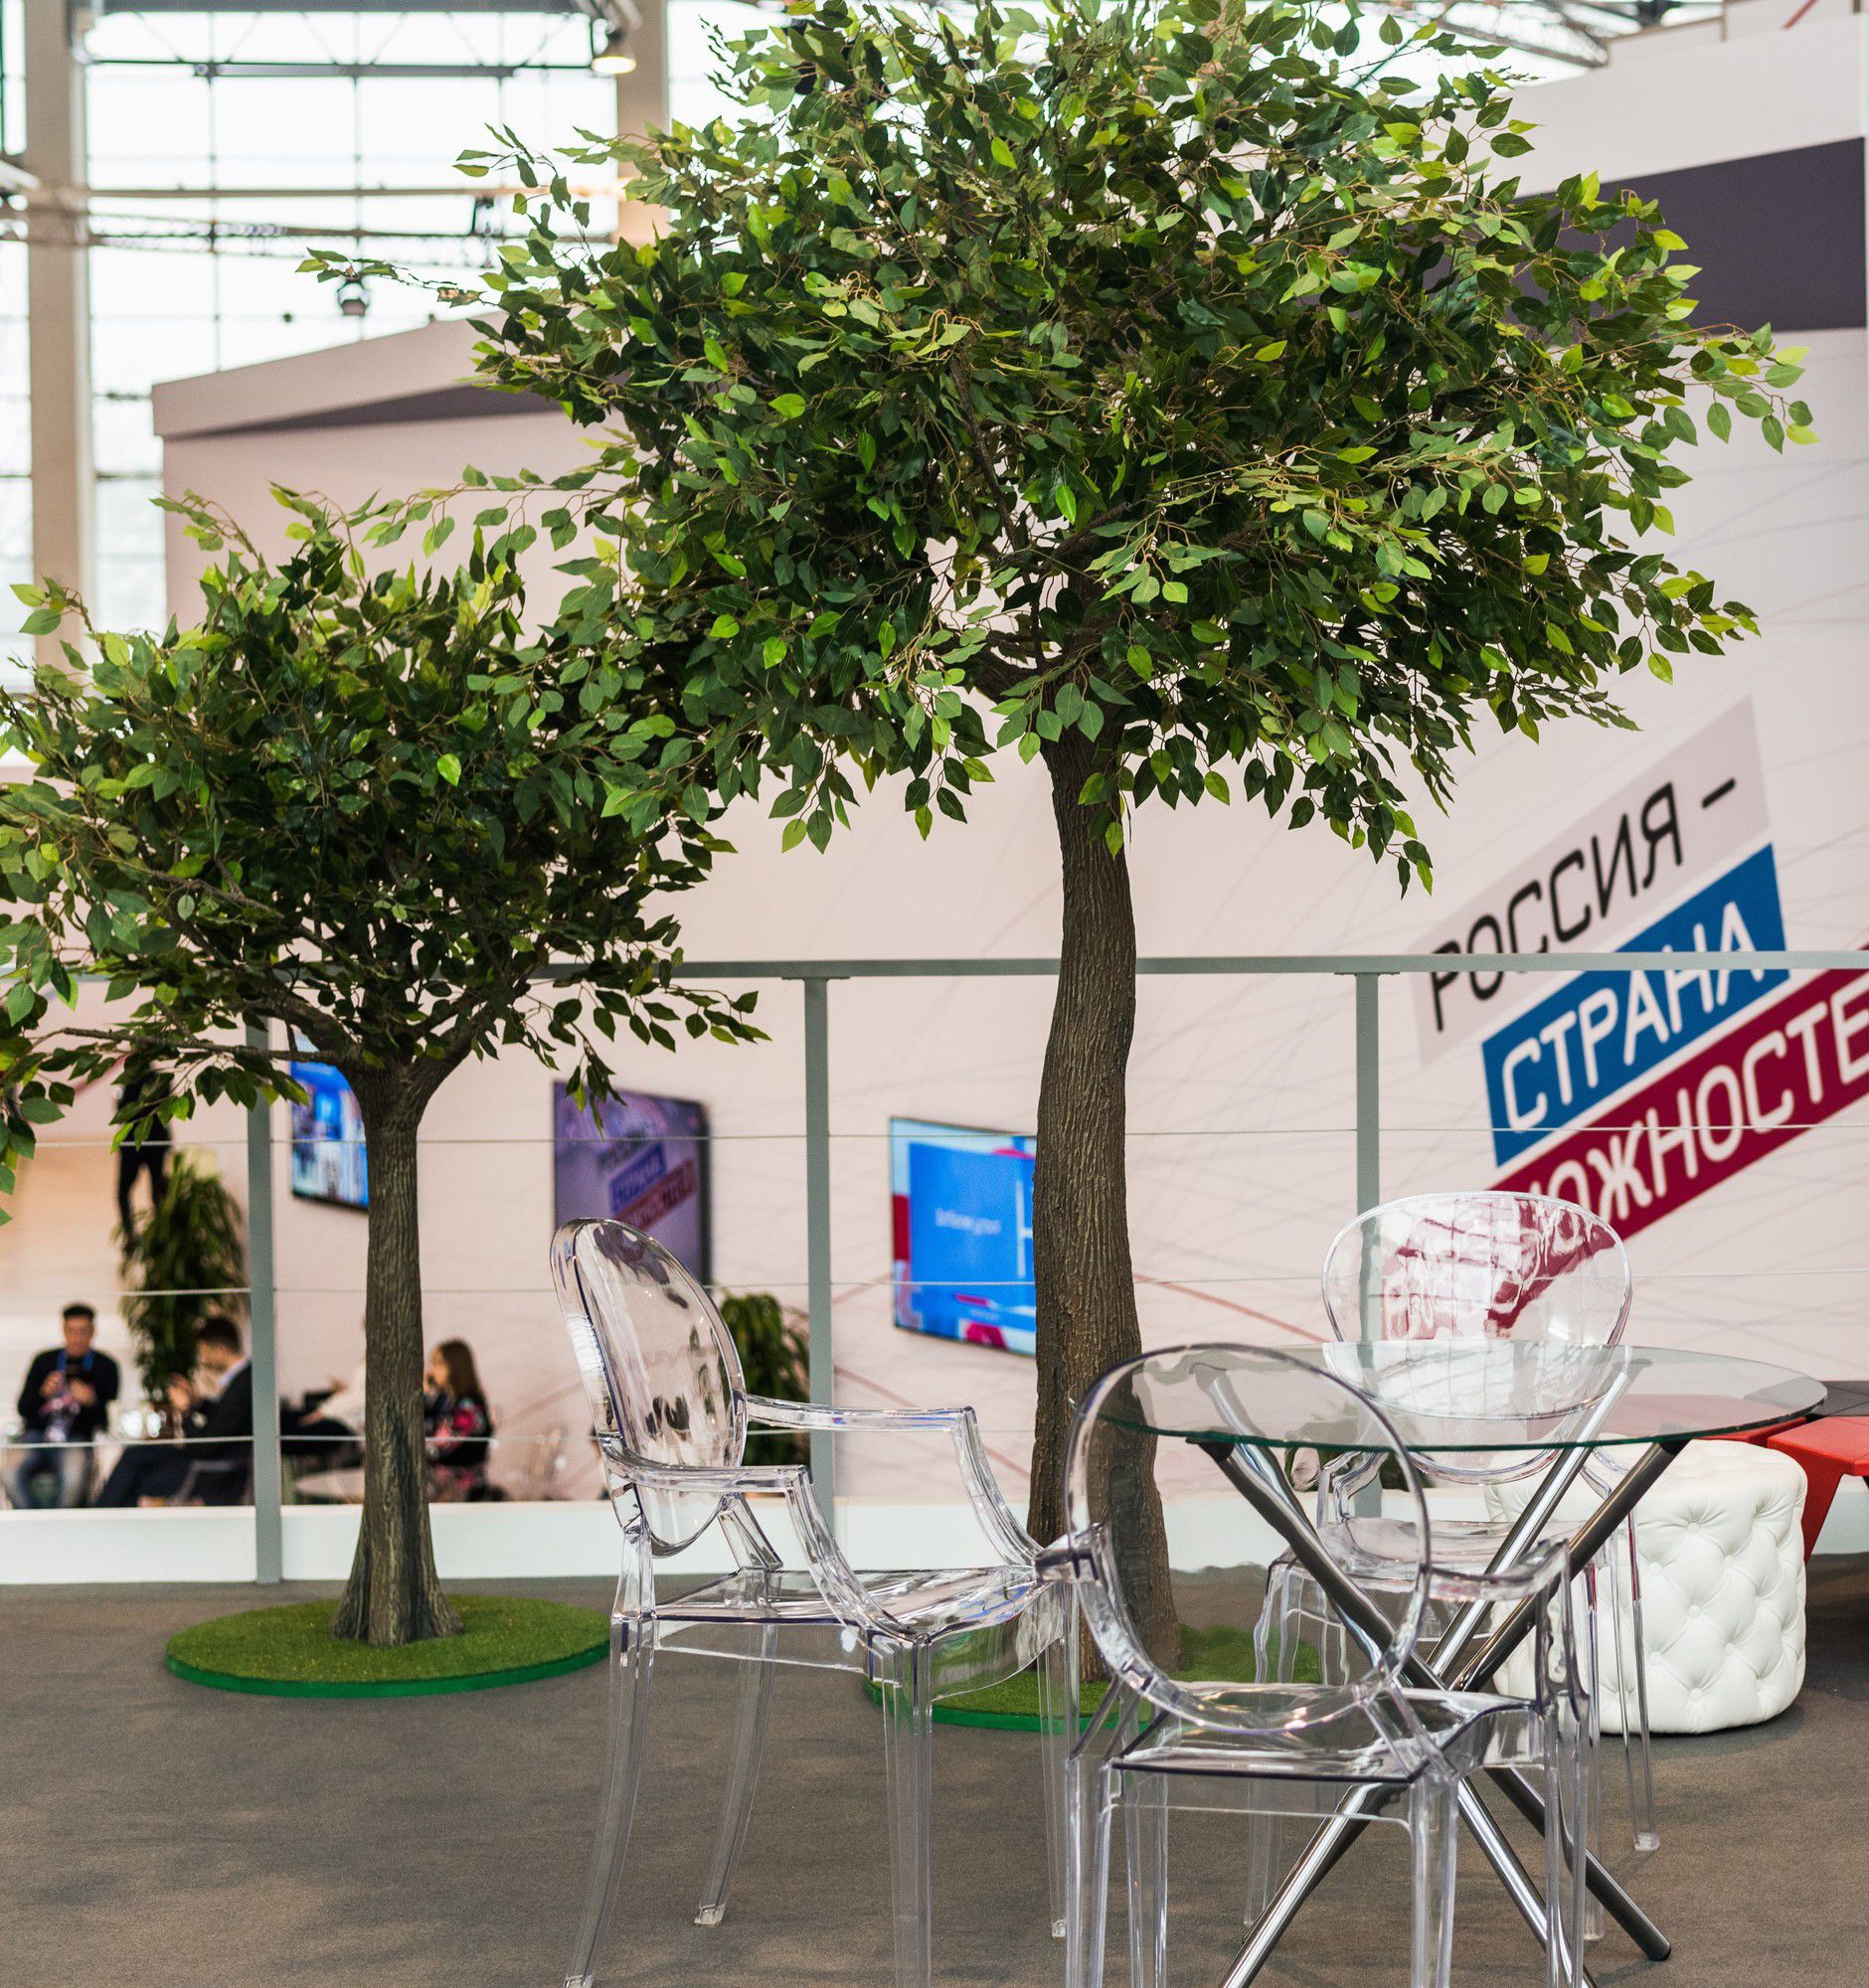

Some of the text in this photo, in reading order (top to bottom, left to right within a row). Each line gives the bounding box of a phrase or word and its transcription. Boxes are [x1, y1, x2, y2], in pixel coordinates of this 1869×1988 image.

[1430, 781, 1682, 1034] РОССИЯ
[1501, 900, 1765, 1132] СТРАНА
[1528, 970, 1869, 1229] ОЖНОСТЕ
